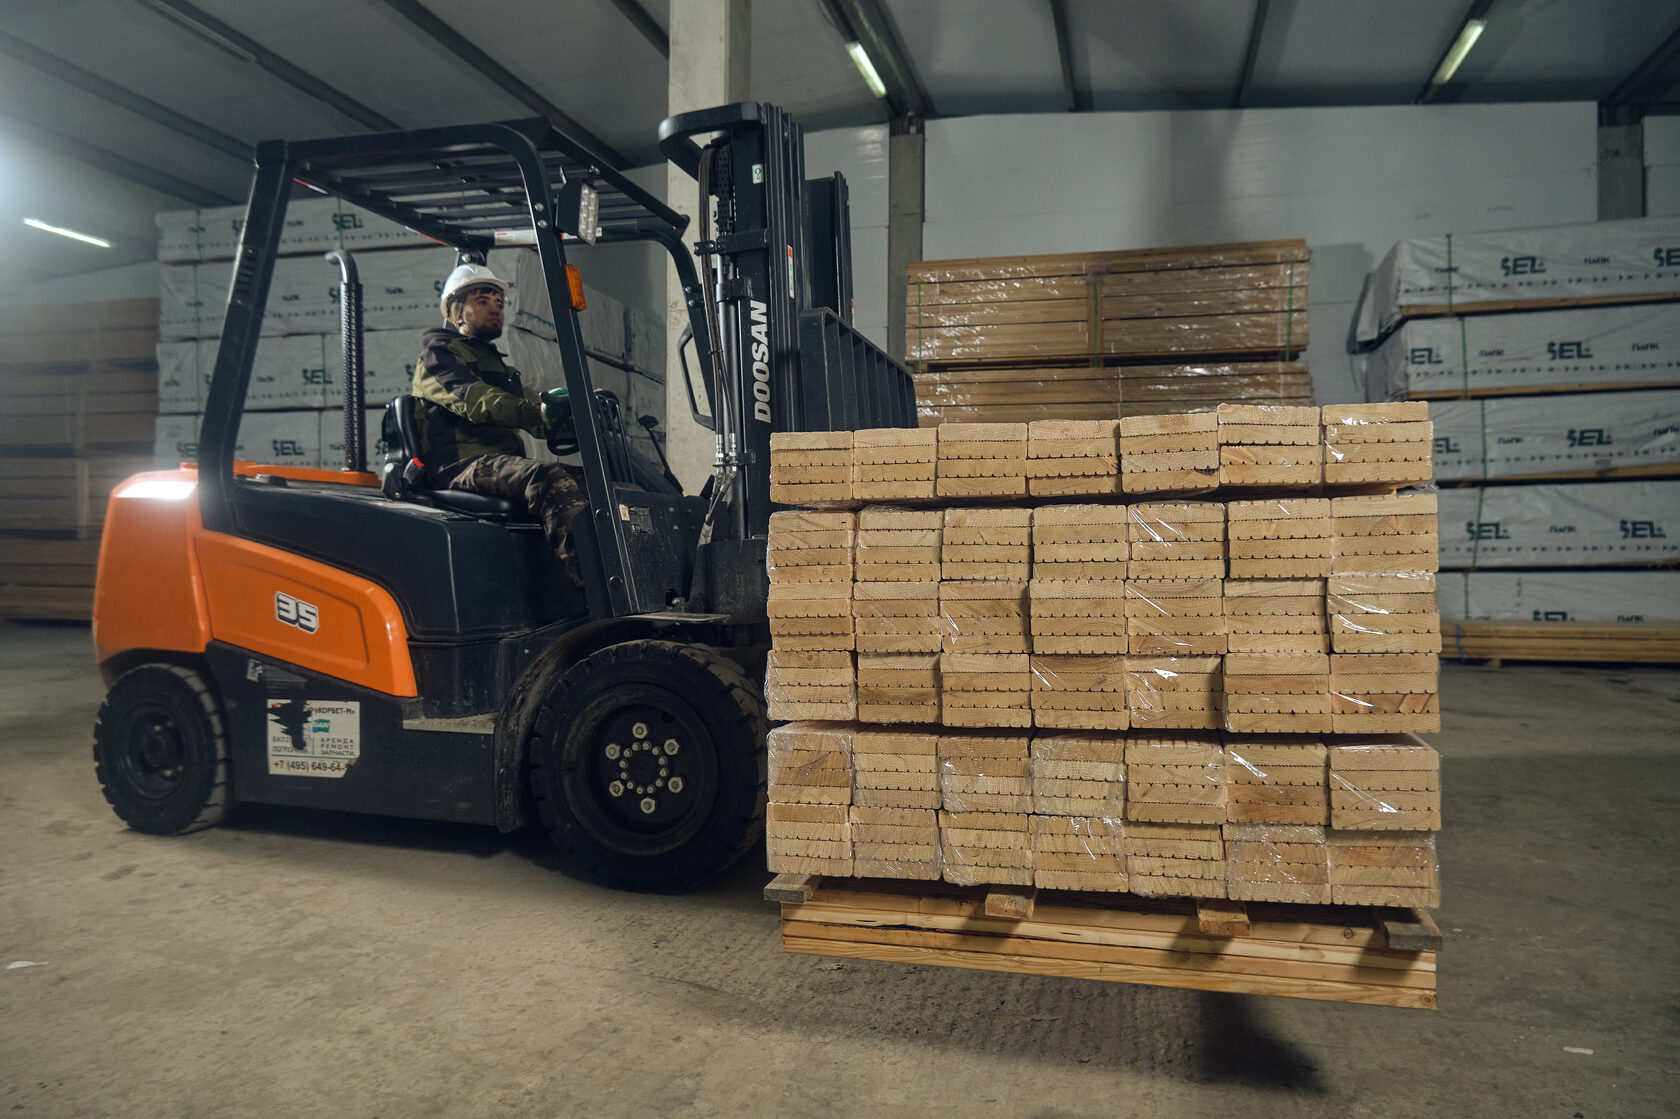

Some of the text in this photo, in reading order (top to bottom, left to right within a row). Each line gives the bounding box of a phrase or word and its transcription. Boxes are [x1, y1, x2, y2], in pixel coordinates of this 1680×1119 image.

[332, 213, 364, 231] SEL
[1501, 256, 1547, 276] SEL
[1653, 247, 1680, 267] SE
[1405, 348, 1443, 365] EL
[1547, 341, 1593, 360] SEL
[750, 299, 772, 424] DOOSAN
[302, 369, 333, 385] SEL
[1567, 428, 1613, 447] SEL
[272, 440, 305, 457] SEL
[1466, 521, 1511, 540] SEL
[1619, 519, 1667, 539] SEL
[275, 592, 318, 633] 35
[273, 760, 285, 769] +7
[287, 760, 309, 772] (495)
